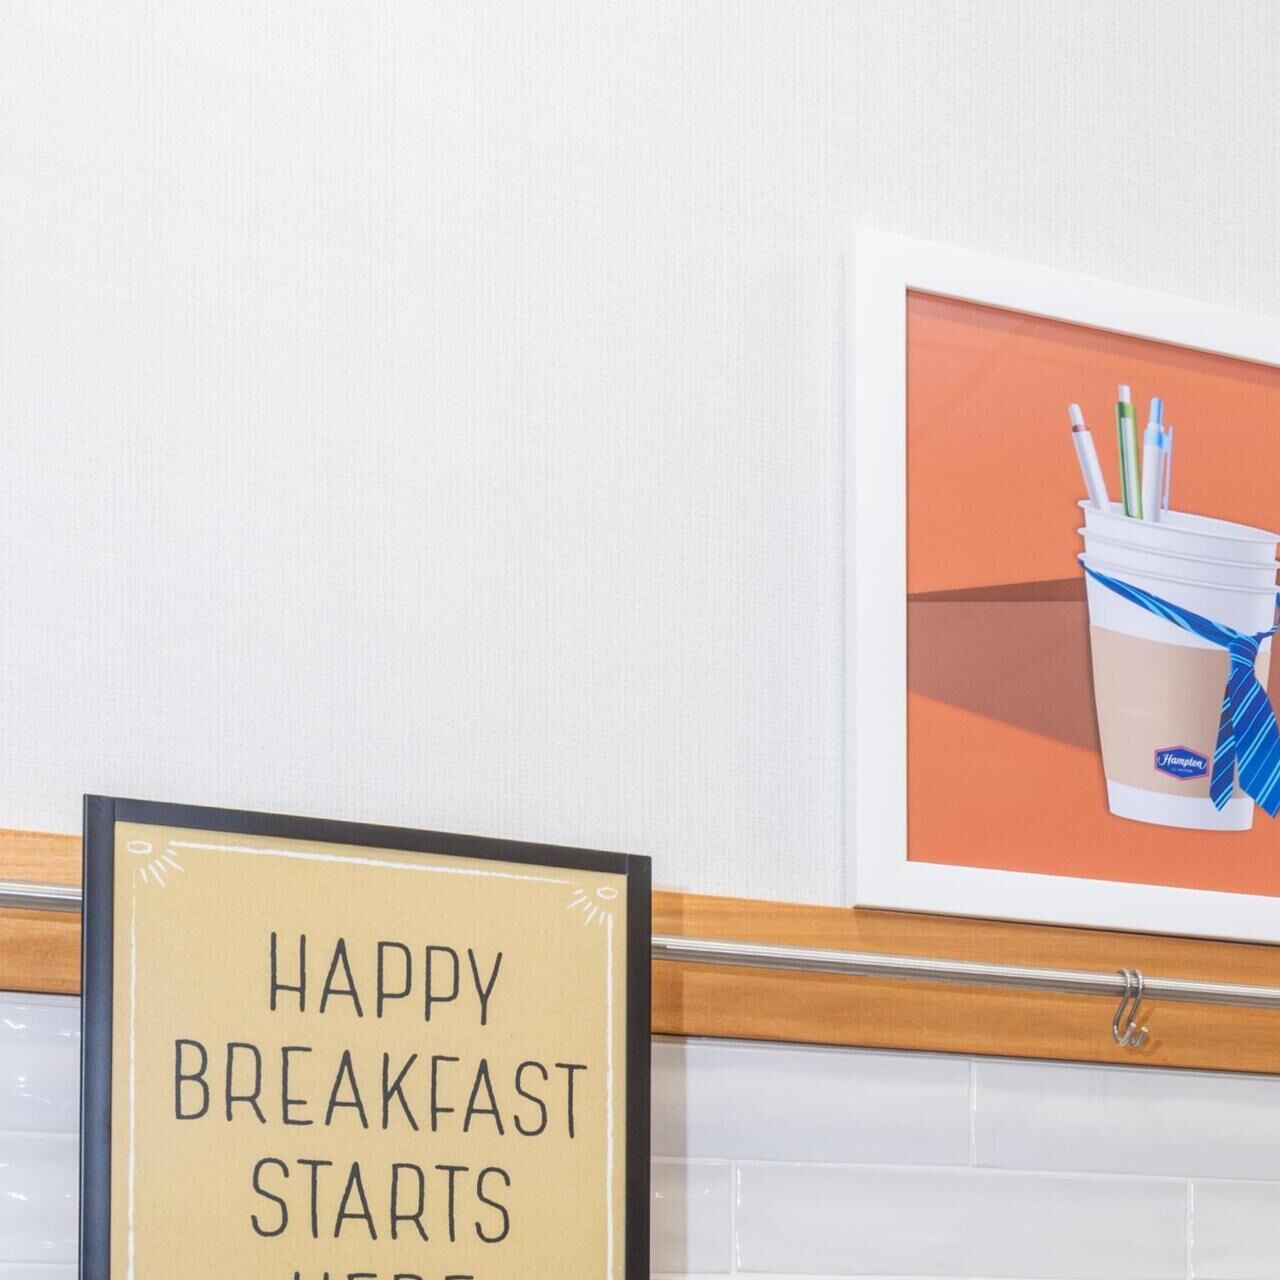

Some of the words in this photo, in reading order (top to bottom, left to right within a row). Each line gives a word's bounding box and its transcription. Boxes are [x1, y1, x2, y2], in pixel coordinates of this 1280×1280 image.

[1158, 753, 1207, 770] Hampton
[269, 931, 503, 1026] HAPPY
[174, 1038, 589, 1140] BREAKFAST
[250, 1156, 512, 1245] STARTS
